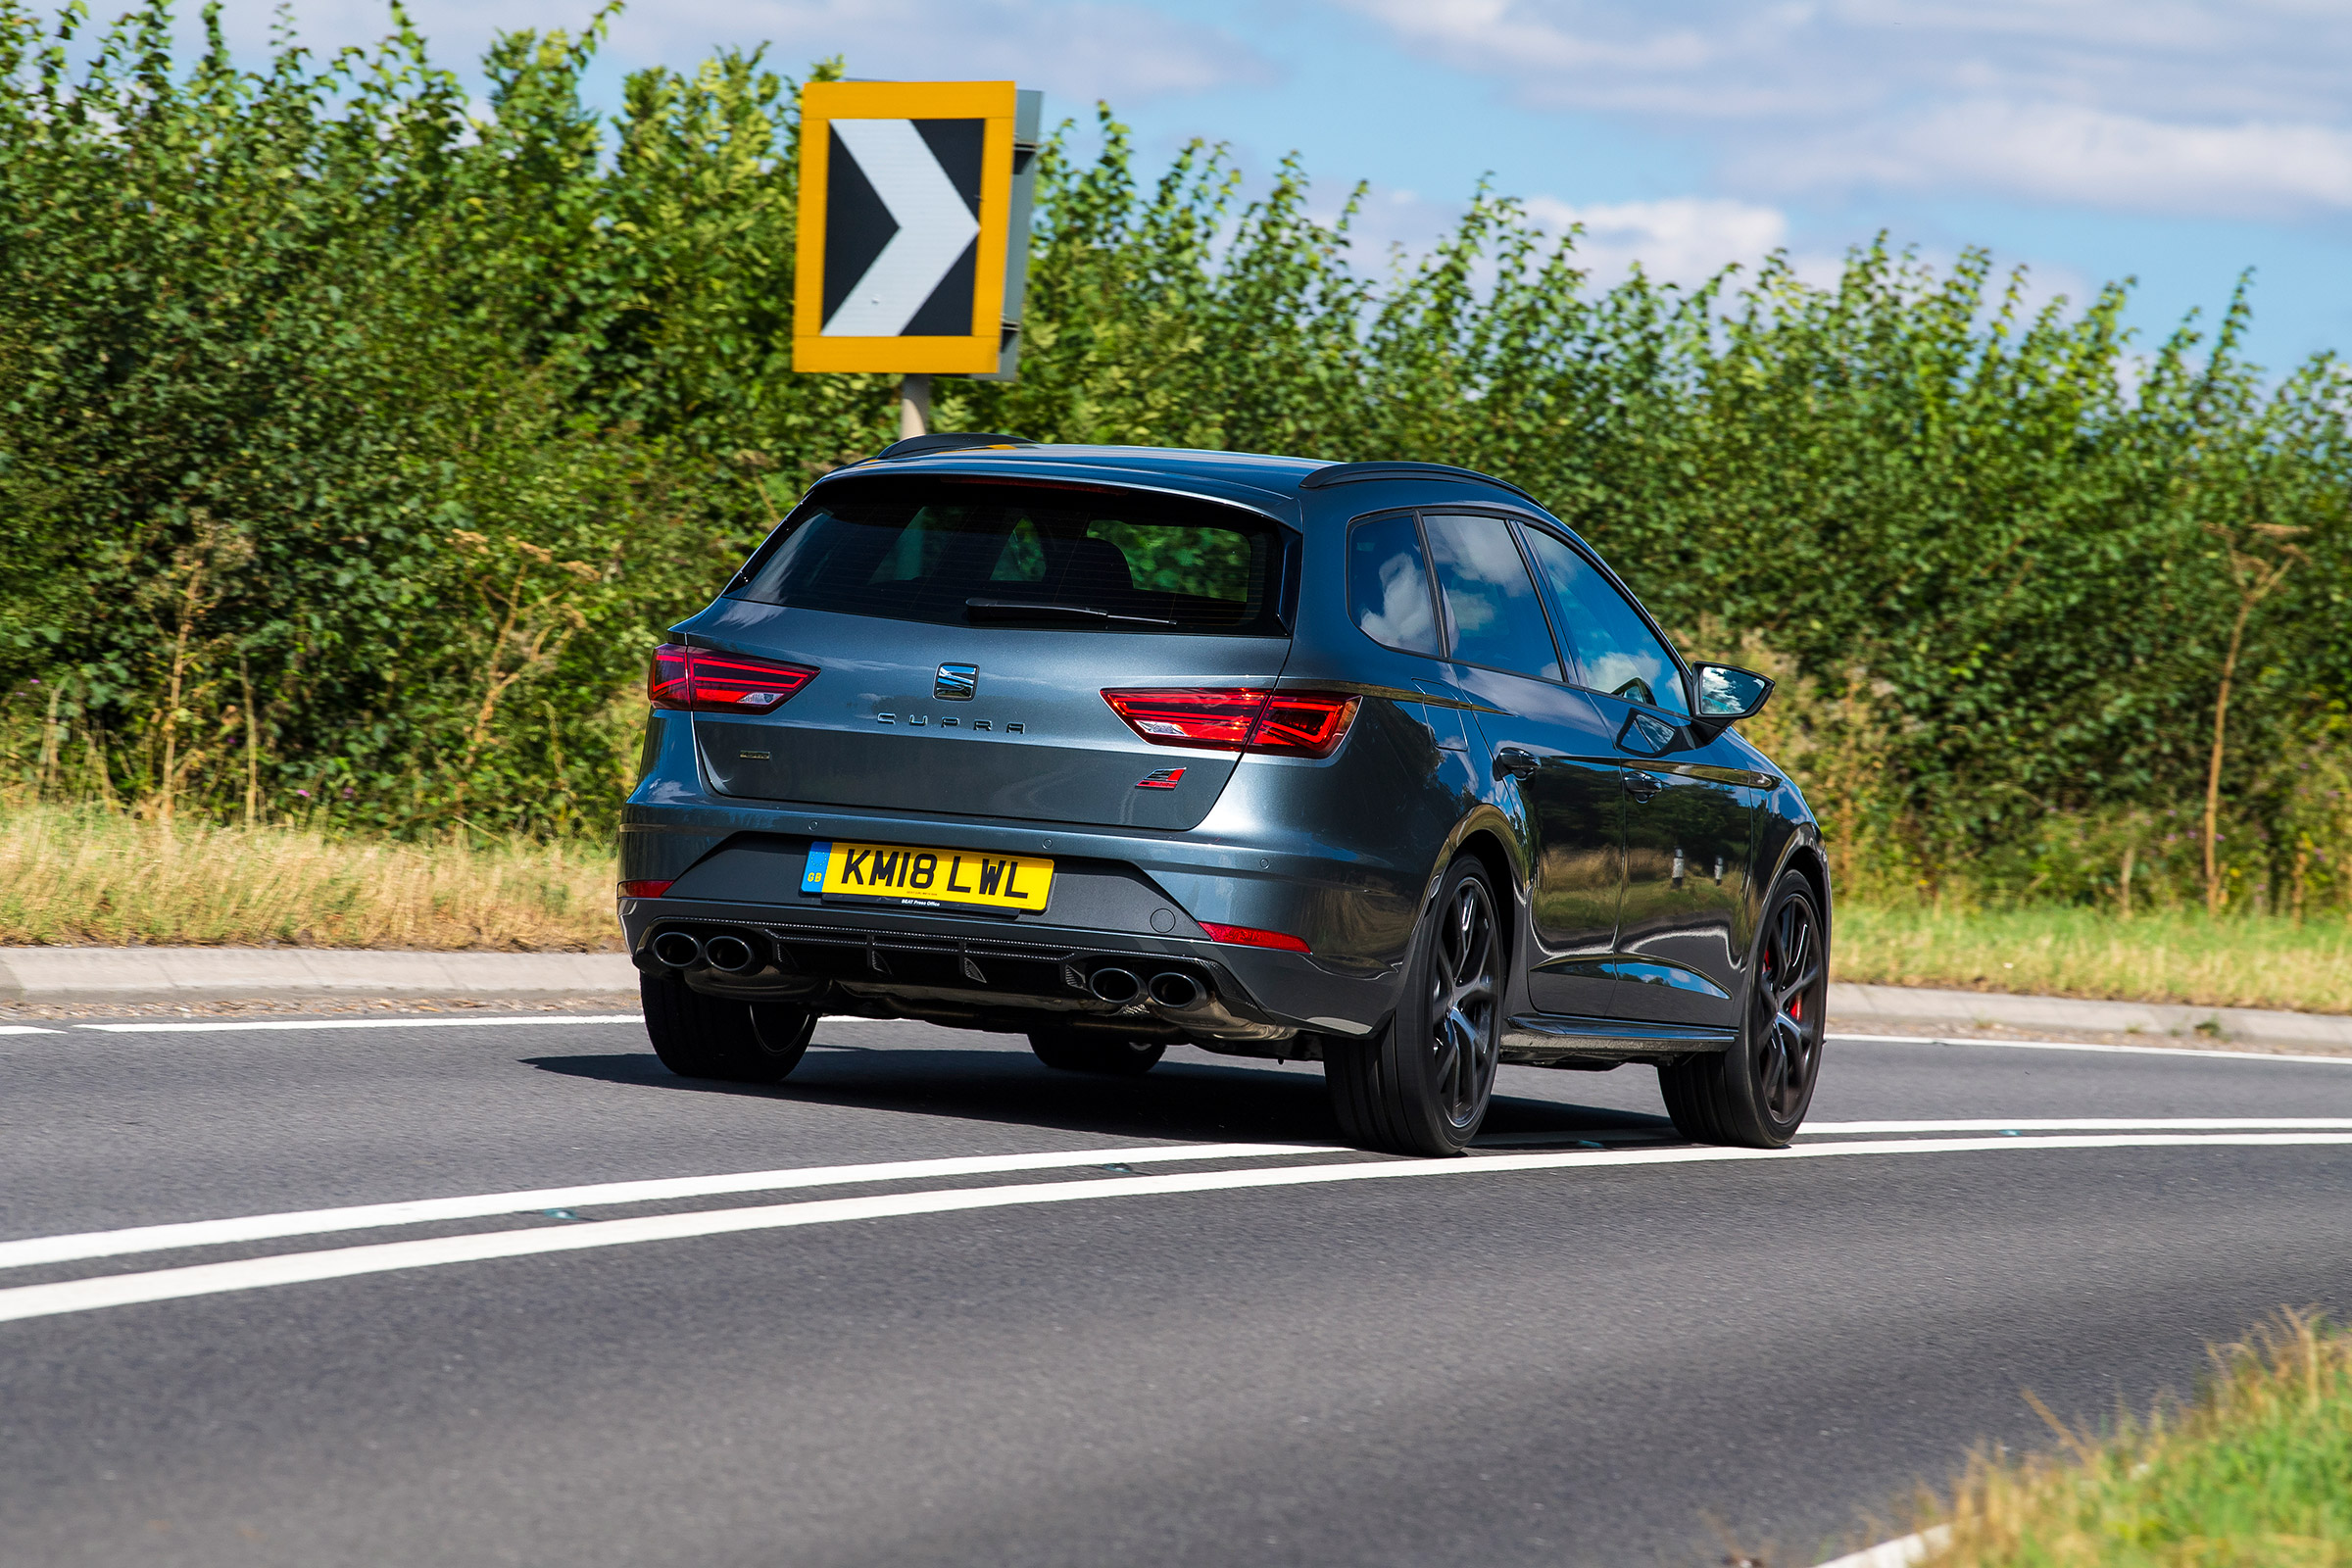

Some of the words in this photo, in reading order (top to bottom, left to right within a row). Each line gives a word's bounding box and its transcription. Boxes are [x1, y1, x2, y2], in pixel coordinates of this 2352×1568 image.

[877, 712, 1025, 734] CUPRA
[808, 872, 822, 882] GB
[841, 849, 938, 889] KM18
[947, 856, 1028, 899] LWL
